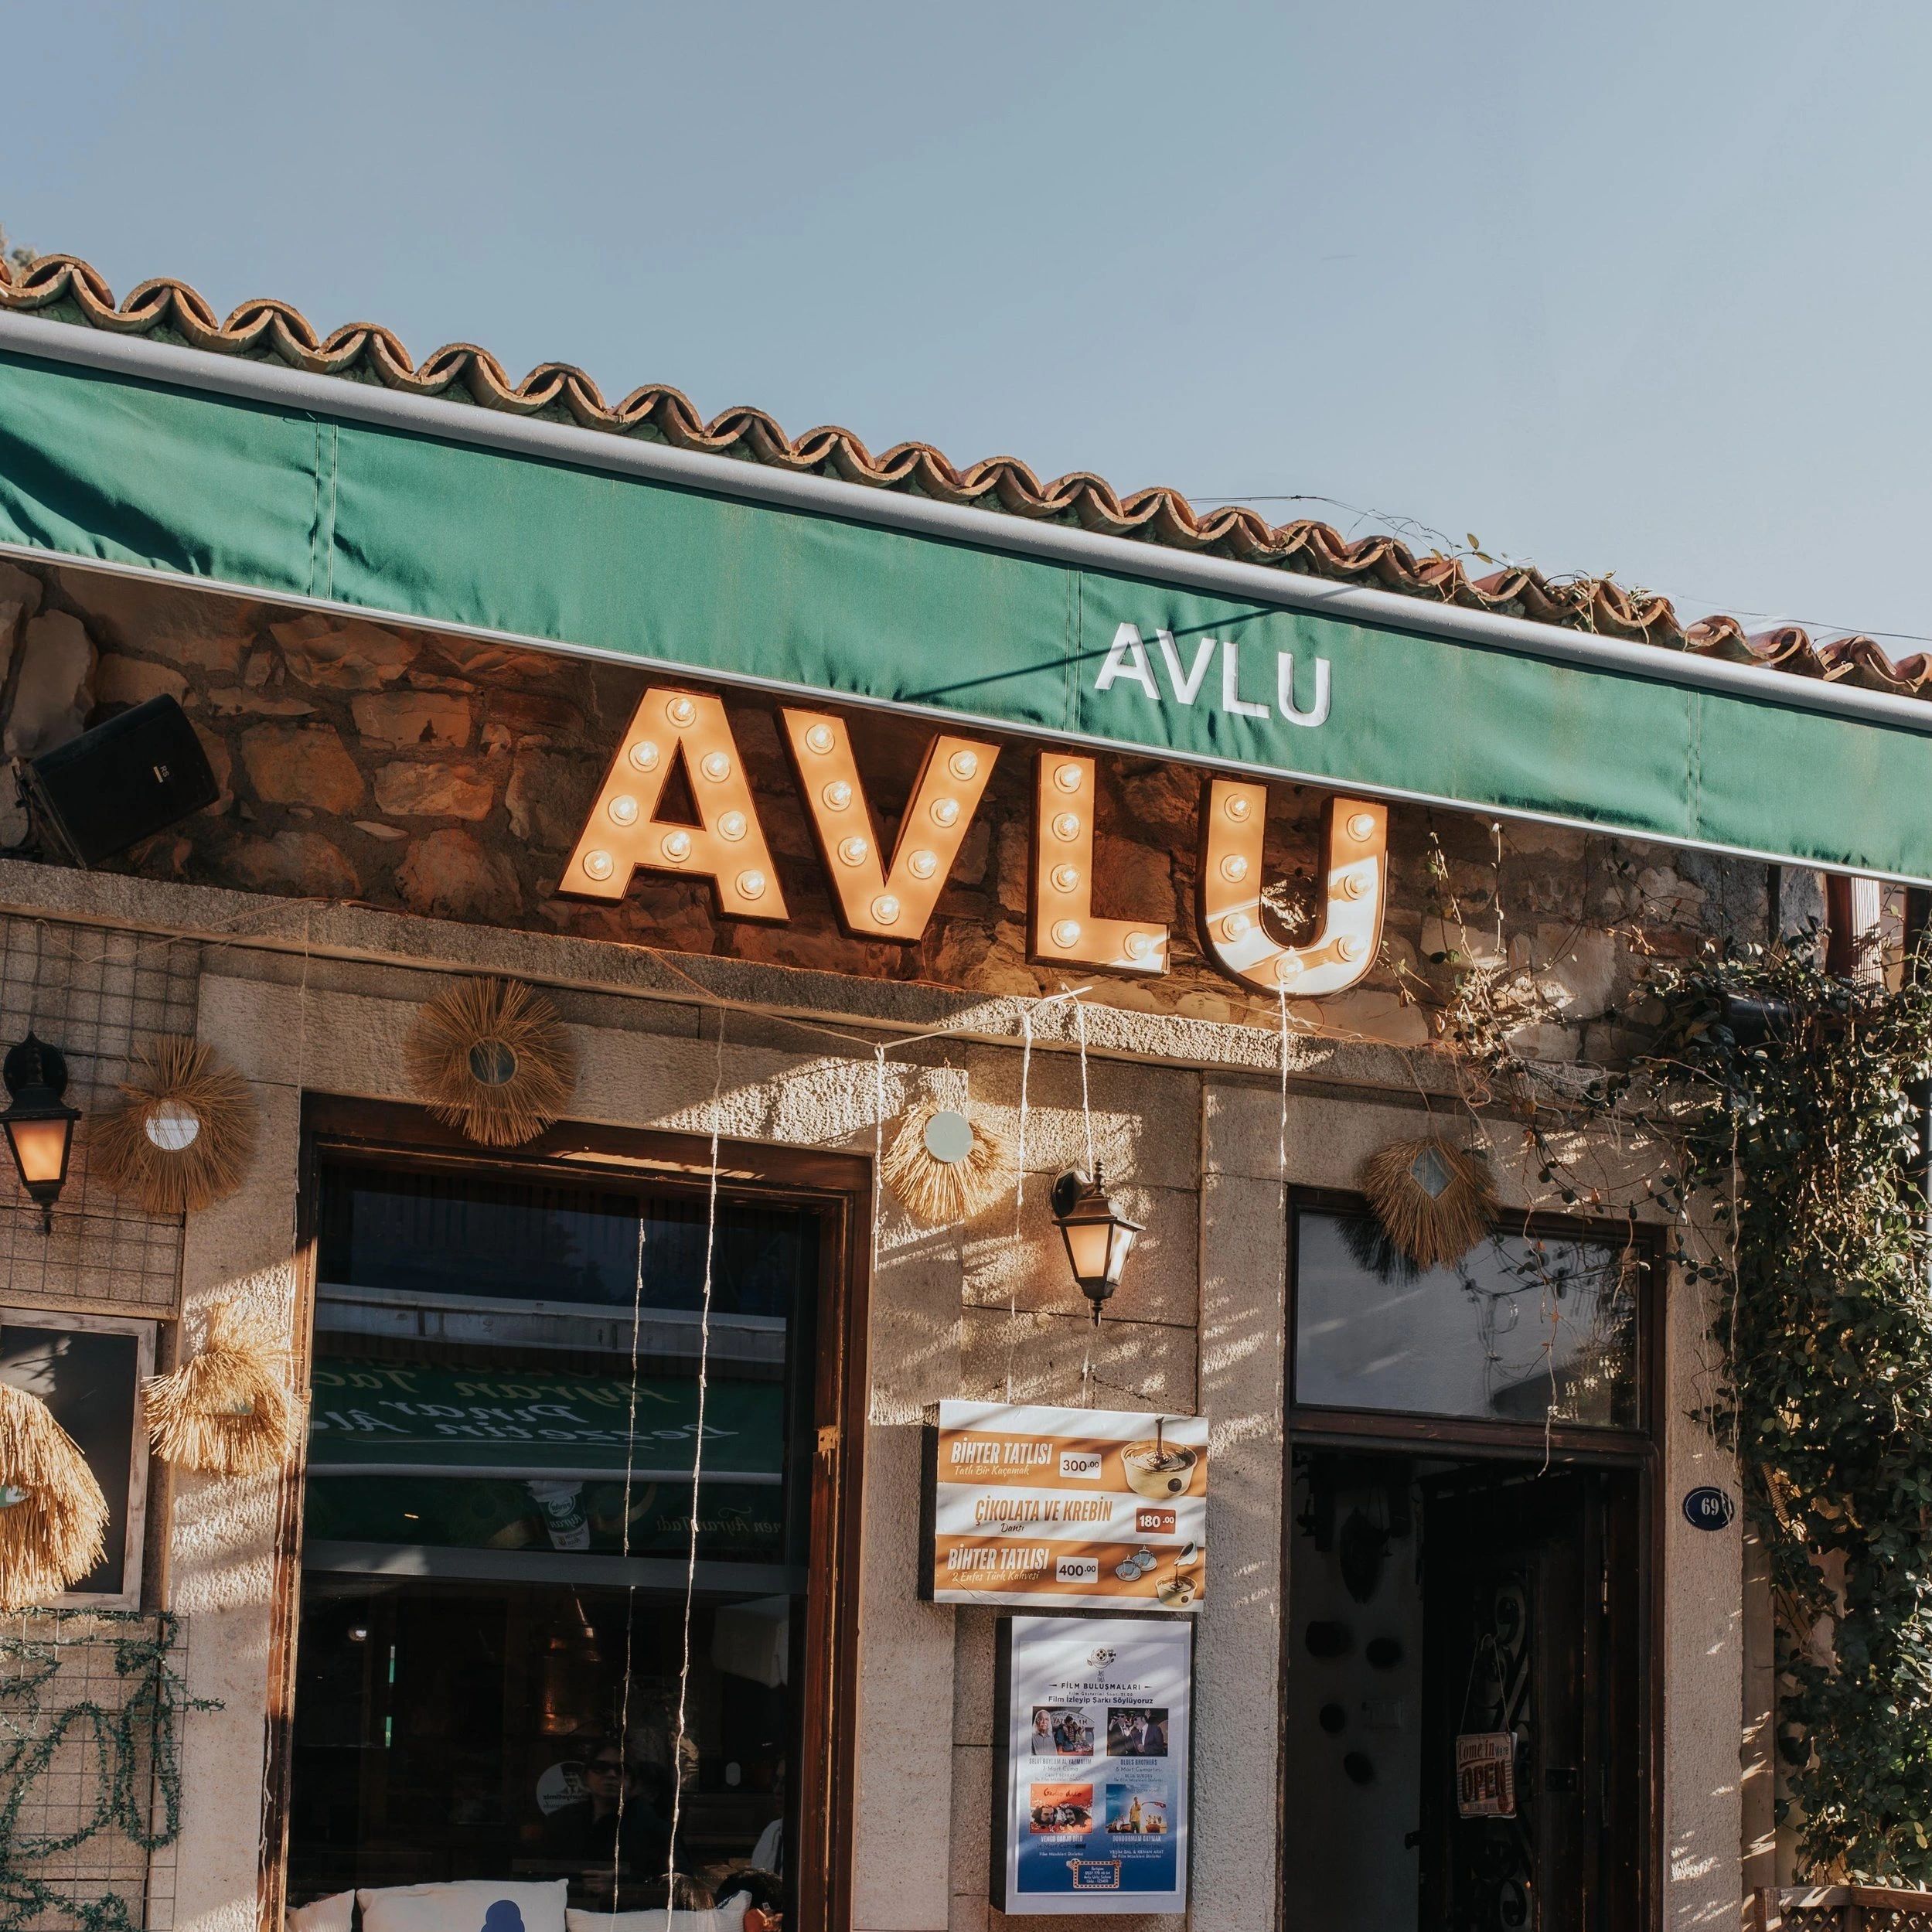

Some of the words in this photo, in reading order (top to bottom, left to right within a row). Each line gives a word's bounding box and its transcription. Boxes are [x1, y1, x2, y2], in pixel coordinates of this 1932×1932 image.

[1094, 622, 1331, 727] AVLU
[557, 686, 1389, 1000] AVLU
[951, 1437, 1000, 1463] BİHTER
[1003, 1443, 1053, 1464] TATLISI
[976, 1466, 990, 1475] Bir
[990, 1465, 1030, 1477] Kaçamak
[1063, 1460, 1099, 1472] 300.00
[974, 1494, 1040, 1525] ÇİKOLATA
[1044, 1500, 1060, 1521] VE
[1062, 1496, 1113, 1521] KREBİN
[1702, 1498, 1719, 1515] 69
[947, 1543, 997, 1570] BİHTER
[1000, 1548, 1050, 1570] TATLISI
[986, 1570, 1006, 1581] Türk
[1007, 1570, 1040, 1580] Kahvesi
[1058, 1564, 1096, 1576] 400.00
[1067, 1695, 1091, 1704] İzleyip
[1459, 1741, 1482, 1760] Come
[1485, 1739, 1495, 1757] in
[1462, 1760, 1506, 1803] OPEN
